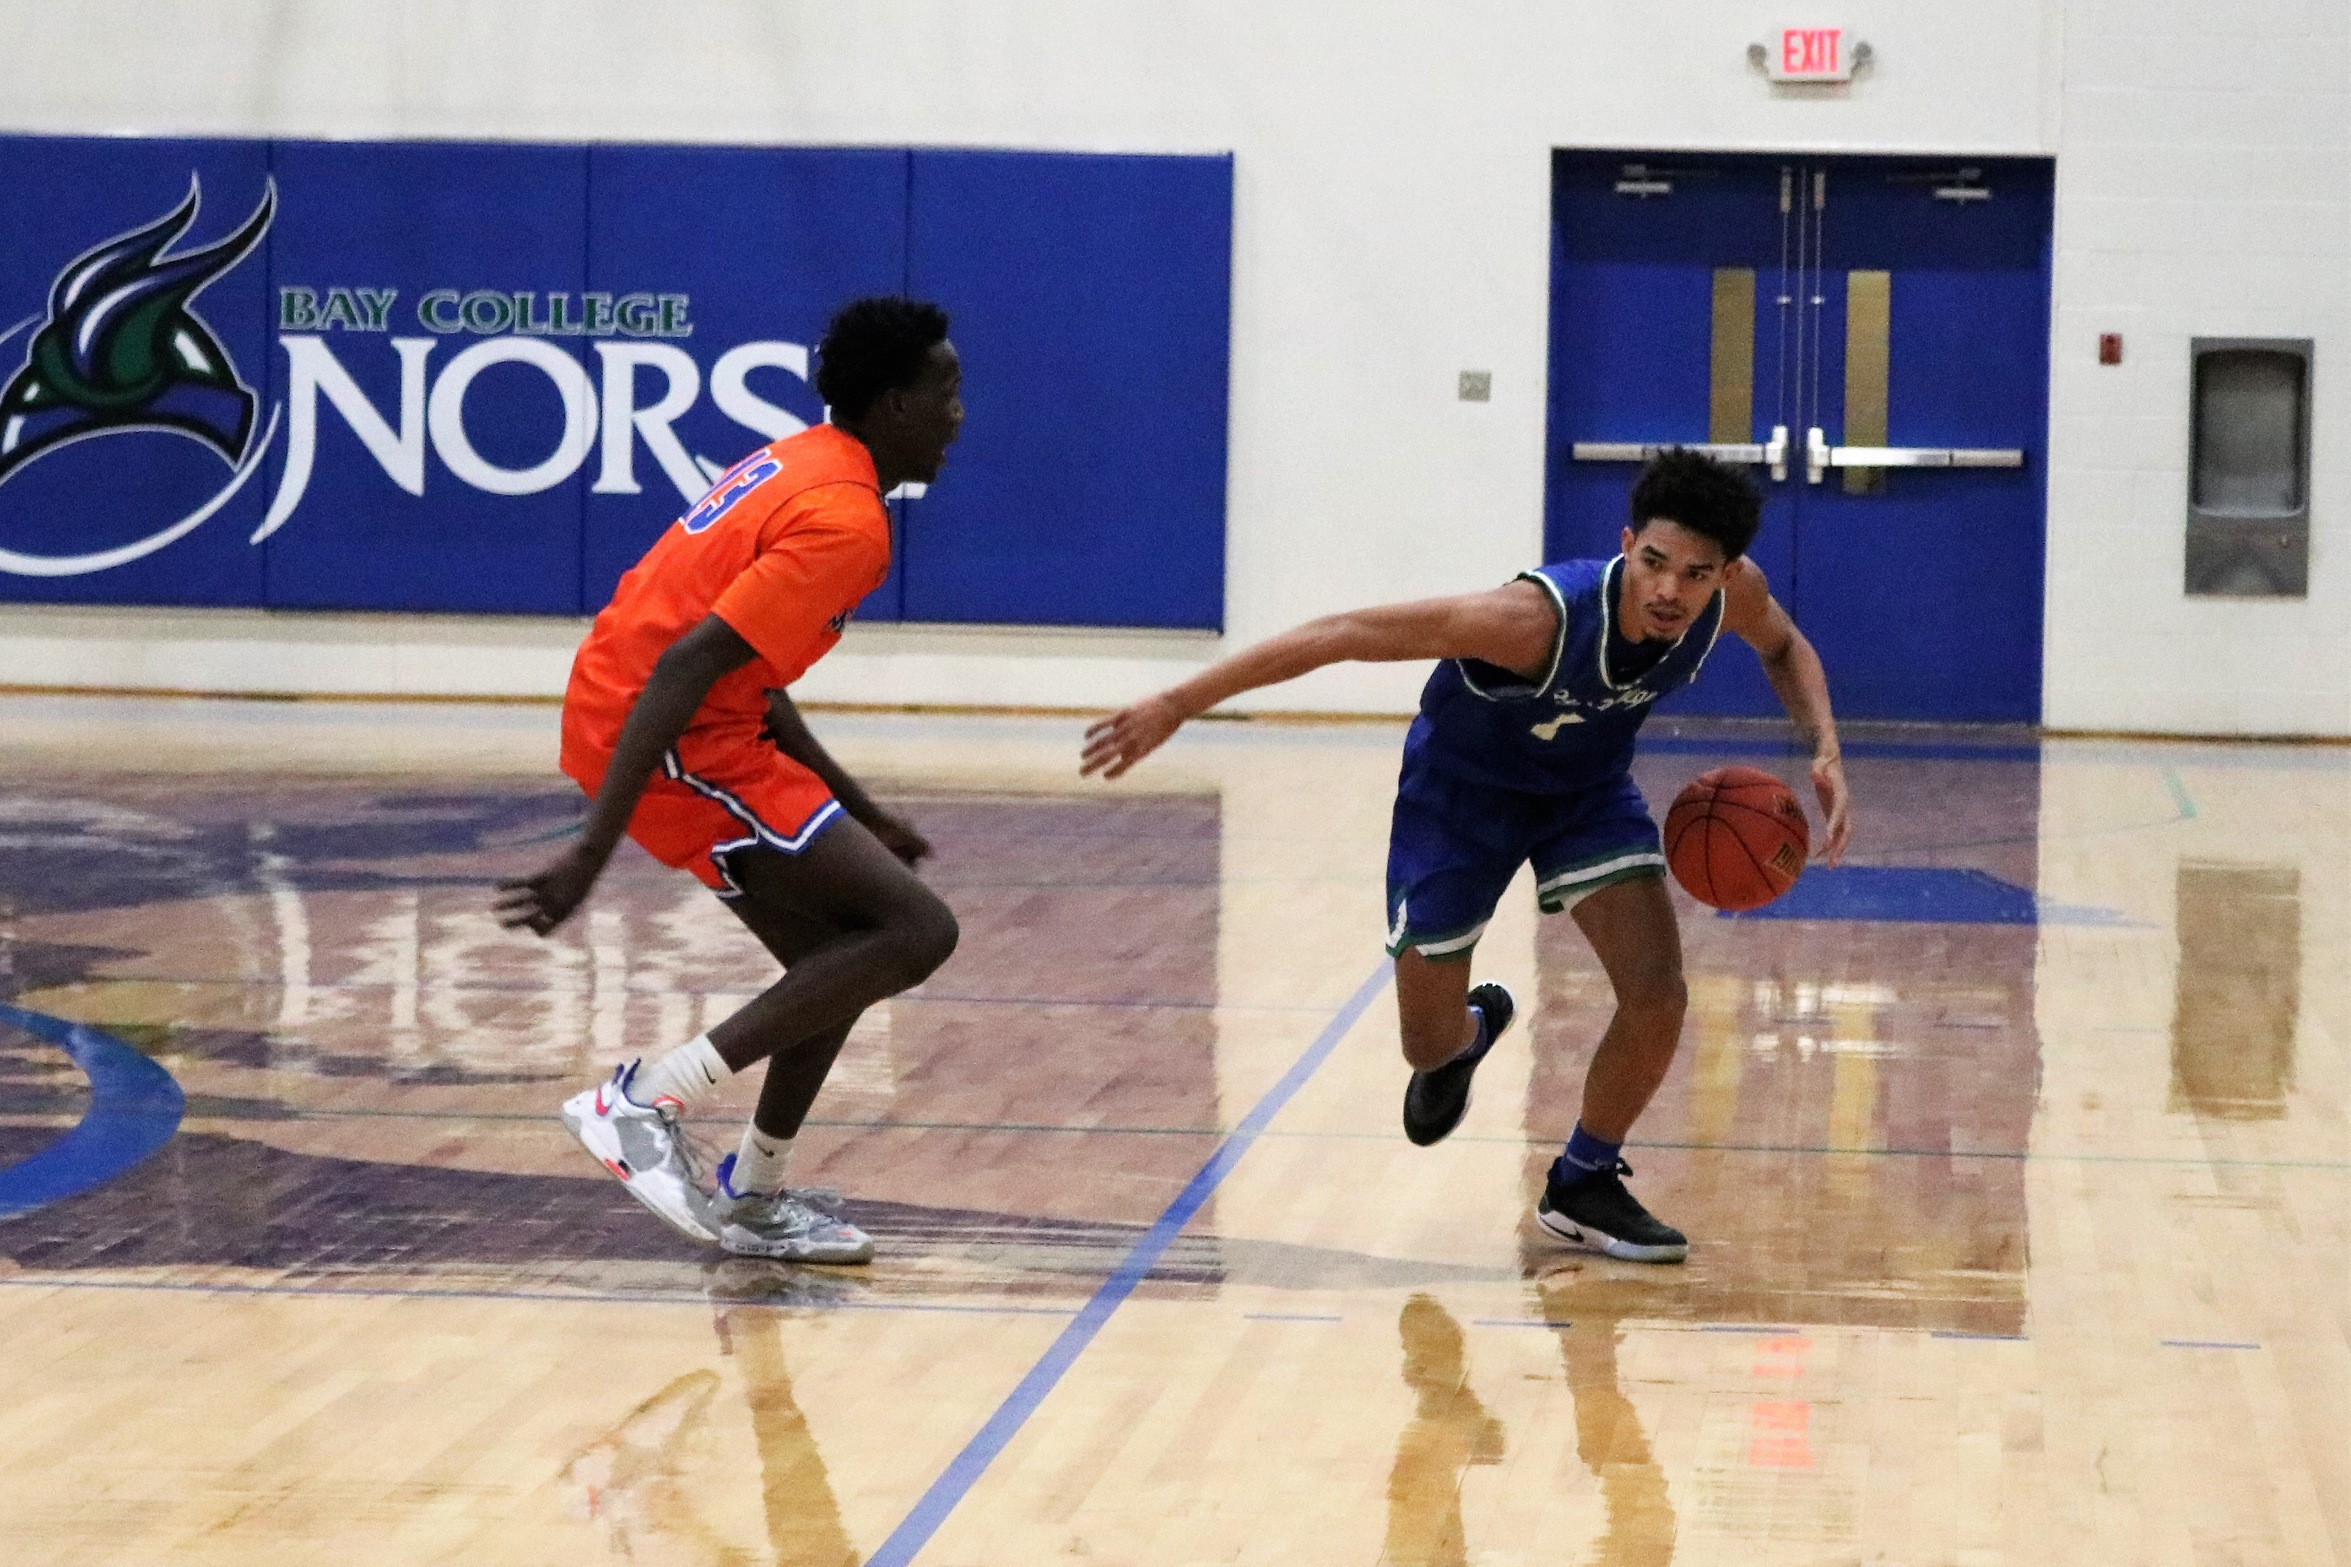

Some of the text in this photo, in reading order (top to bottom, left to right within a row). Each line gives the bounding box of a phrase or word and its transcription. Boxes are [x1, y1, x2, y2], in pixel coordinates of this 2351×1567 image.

[1782, 28, 1843, 73] EXIT
[279, 286, 694, 338] BAY COLLEGE
[250, 337, 929, 545] NORS
